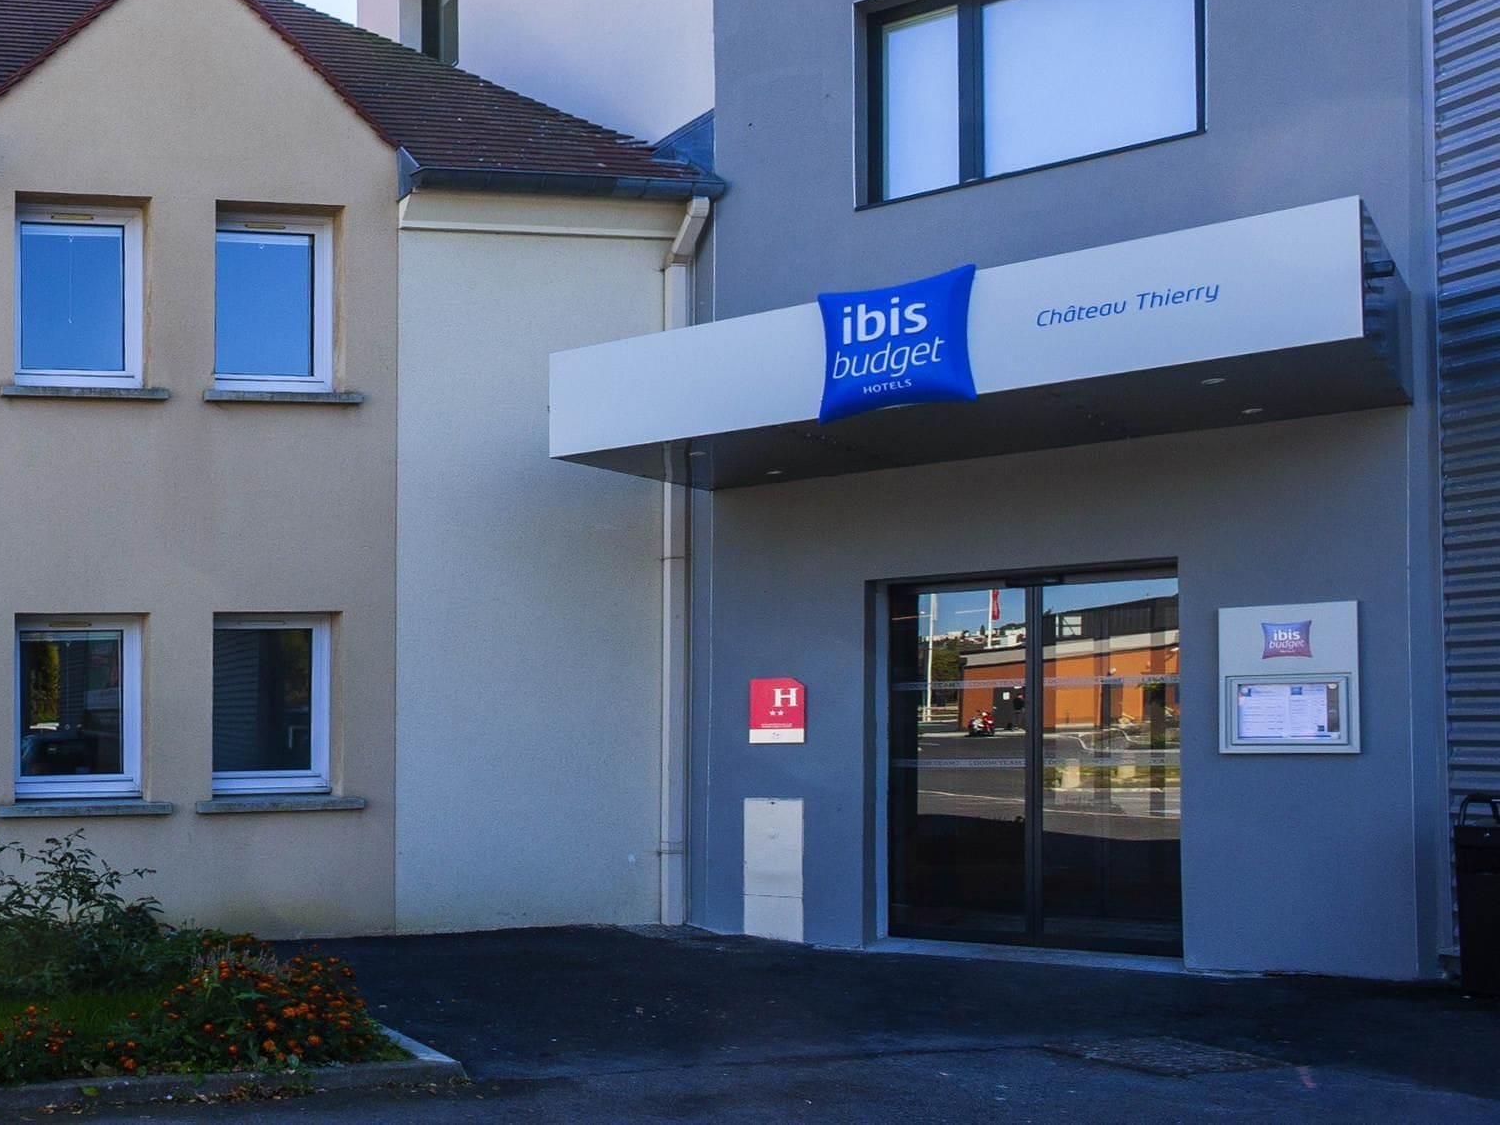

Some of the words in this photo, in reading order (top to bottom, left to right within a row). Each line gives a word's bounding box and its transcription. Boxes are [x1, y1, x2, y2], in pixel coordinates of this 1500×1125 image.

[1036, 299, 1127, 327] Château
[1136, 284, 1220, 310] Thierry
[842, 296, 928, 345] ibis
[832, 336, 945, 379] budget
[862, 378, 913, 394] HOTELS
[1269, 639, 1306, 650] budget
[1273, 629, 1300, 642] ibis
[772, 687, 799, 707] H
